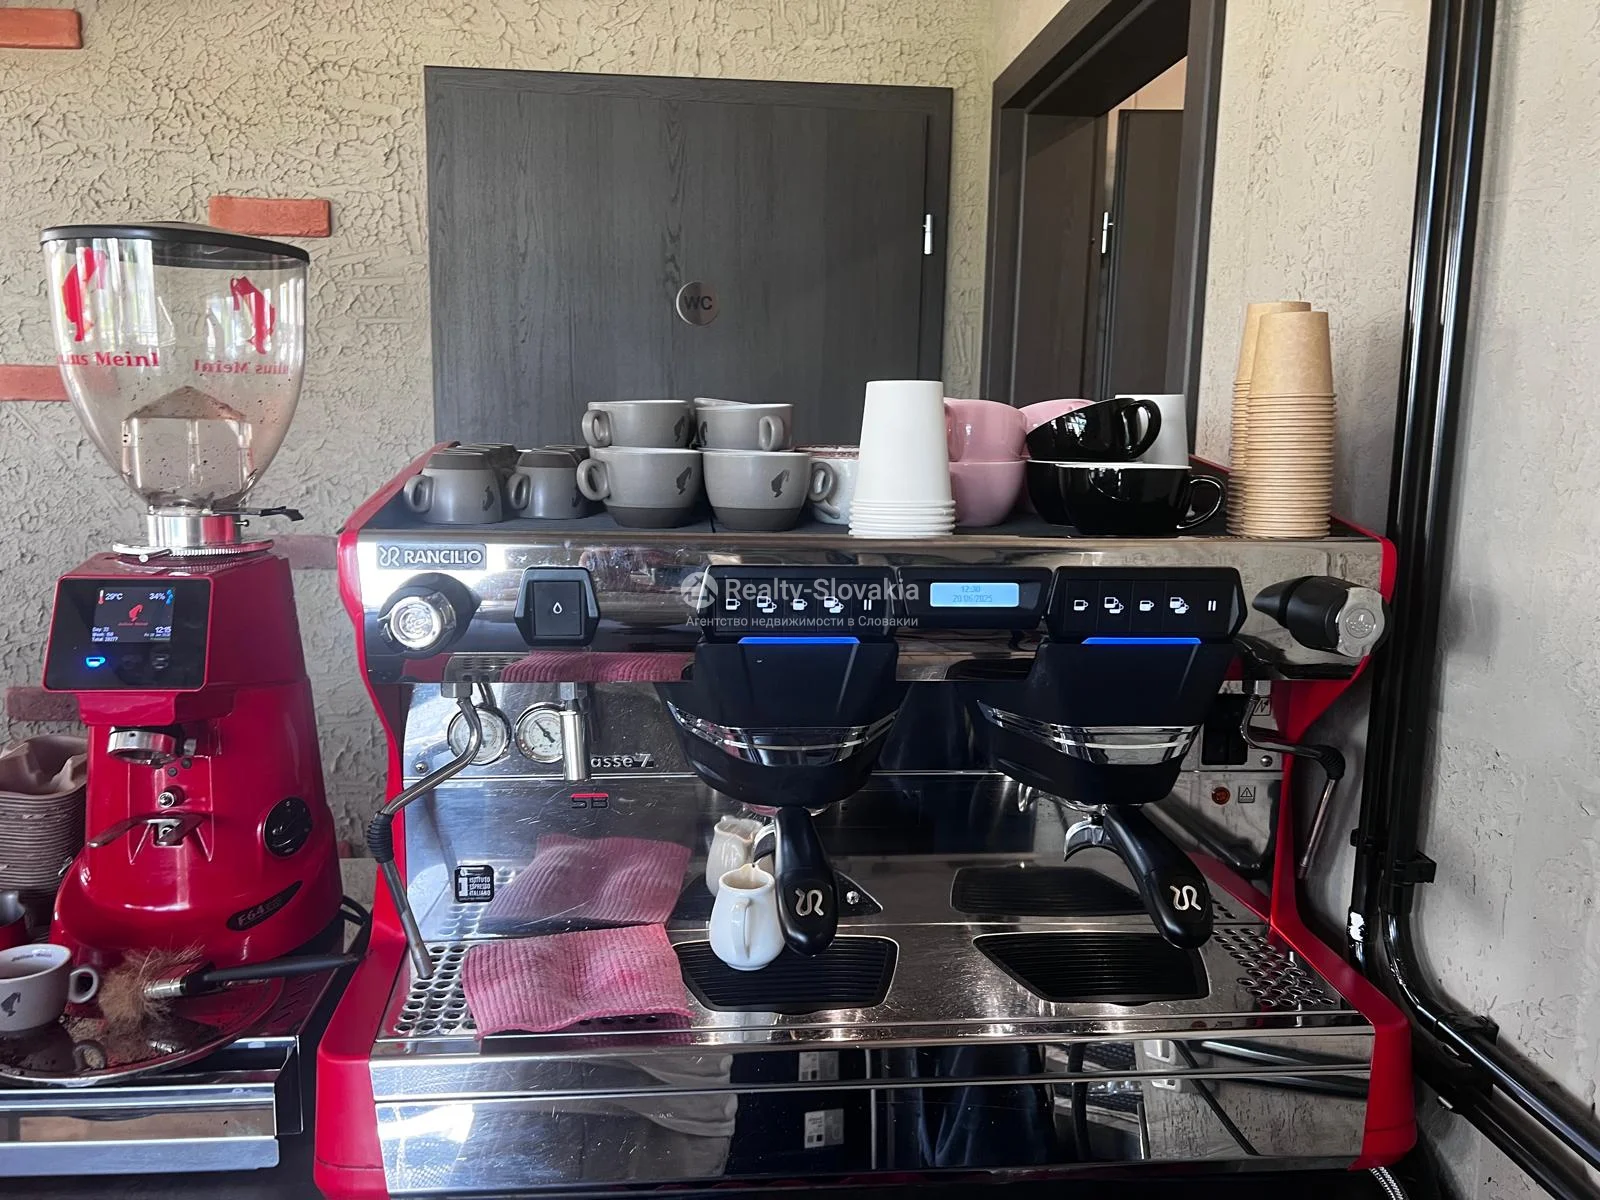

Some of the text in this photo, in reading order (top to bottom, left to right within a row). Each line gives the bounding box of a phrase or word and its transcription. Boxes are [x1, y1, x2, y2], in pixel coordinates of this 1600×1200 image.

[684, 295, 713, 311] WC
[95, 350, 160, 367] Meinl
[404, 550, 482, 564] RANCILIO
[590, 753, 651, 768] asse 7
